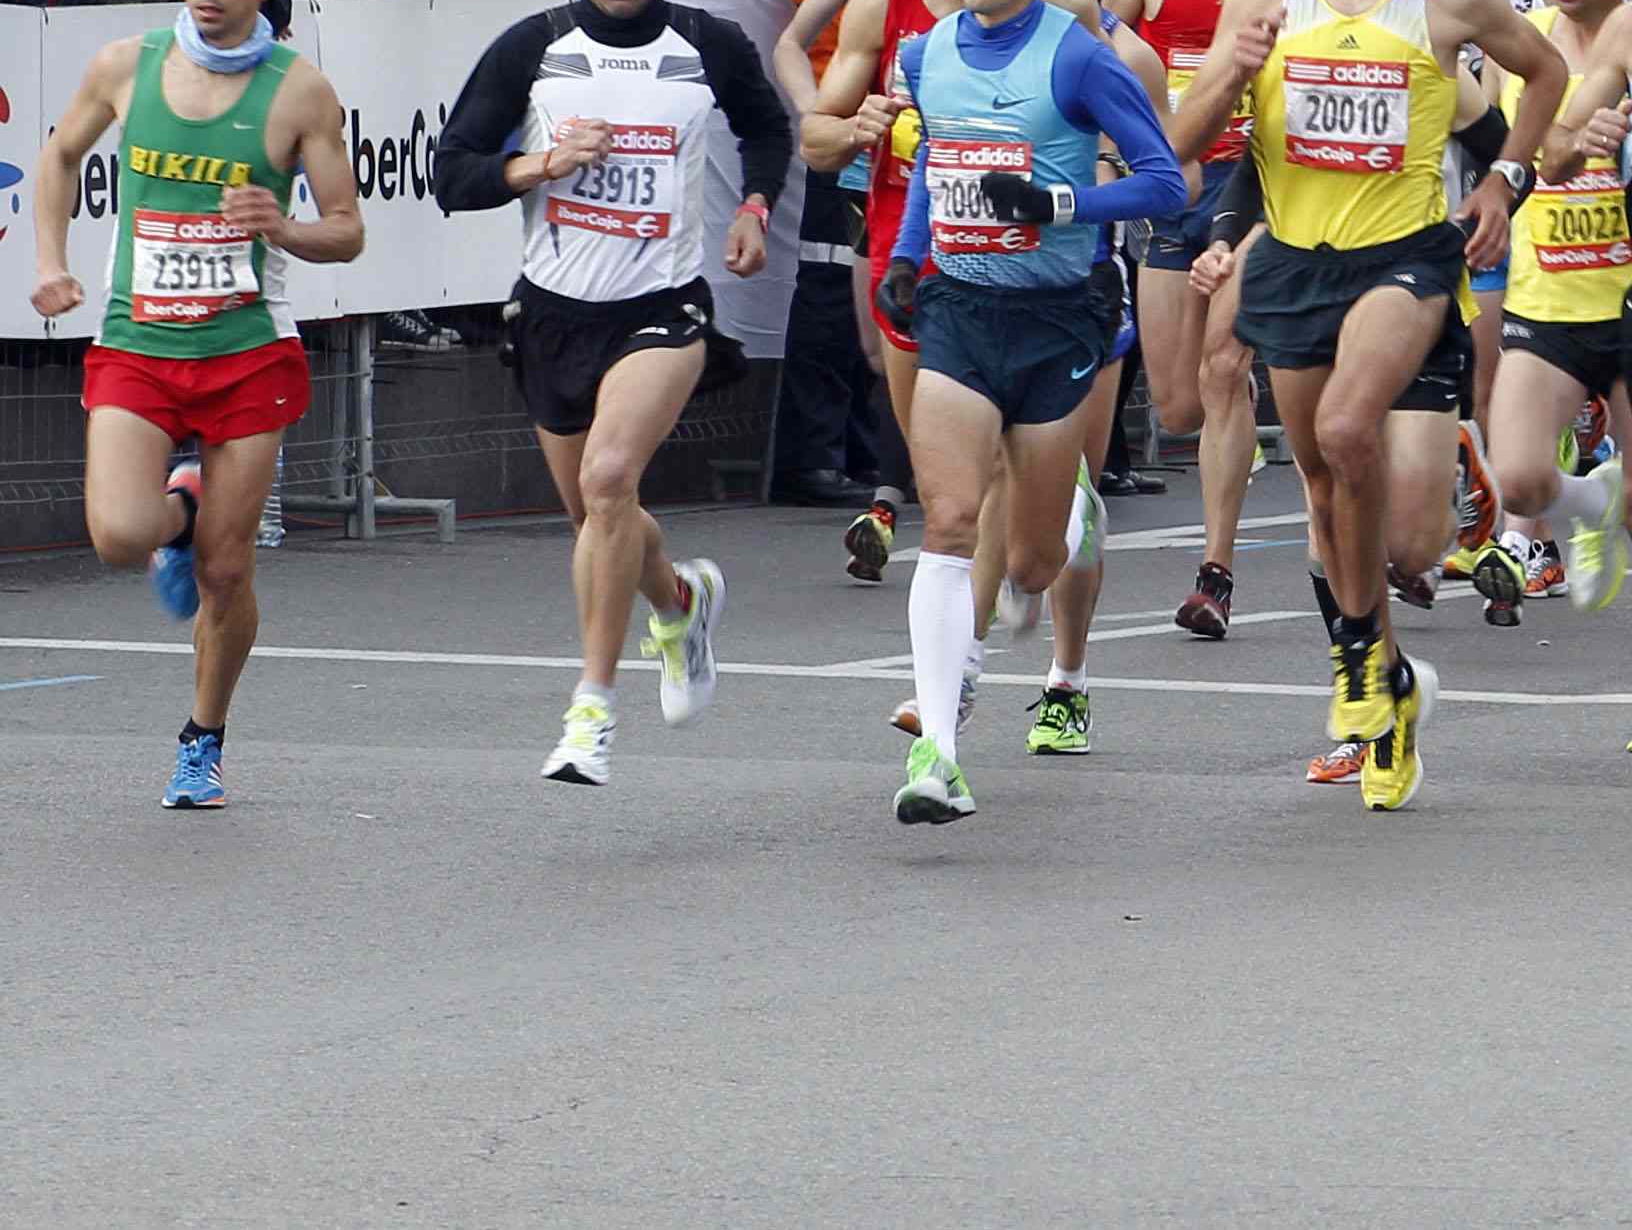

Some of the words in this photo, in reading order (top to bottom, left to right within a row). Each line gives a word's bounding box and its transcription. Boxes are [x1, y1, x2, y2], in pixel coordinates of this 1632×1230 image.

[1333, 63, 1404, 84] adidas
[1305, 95, 1388, 135] 20010
[961, 148, 1025, 166] adidas
[572, 164, 656, 205] 23913
[1546, 205, 1624, 242] 20022
[153, 253, 236, 289] 23913
